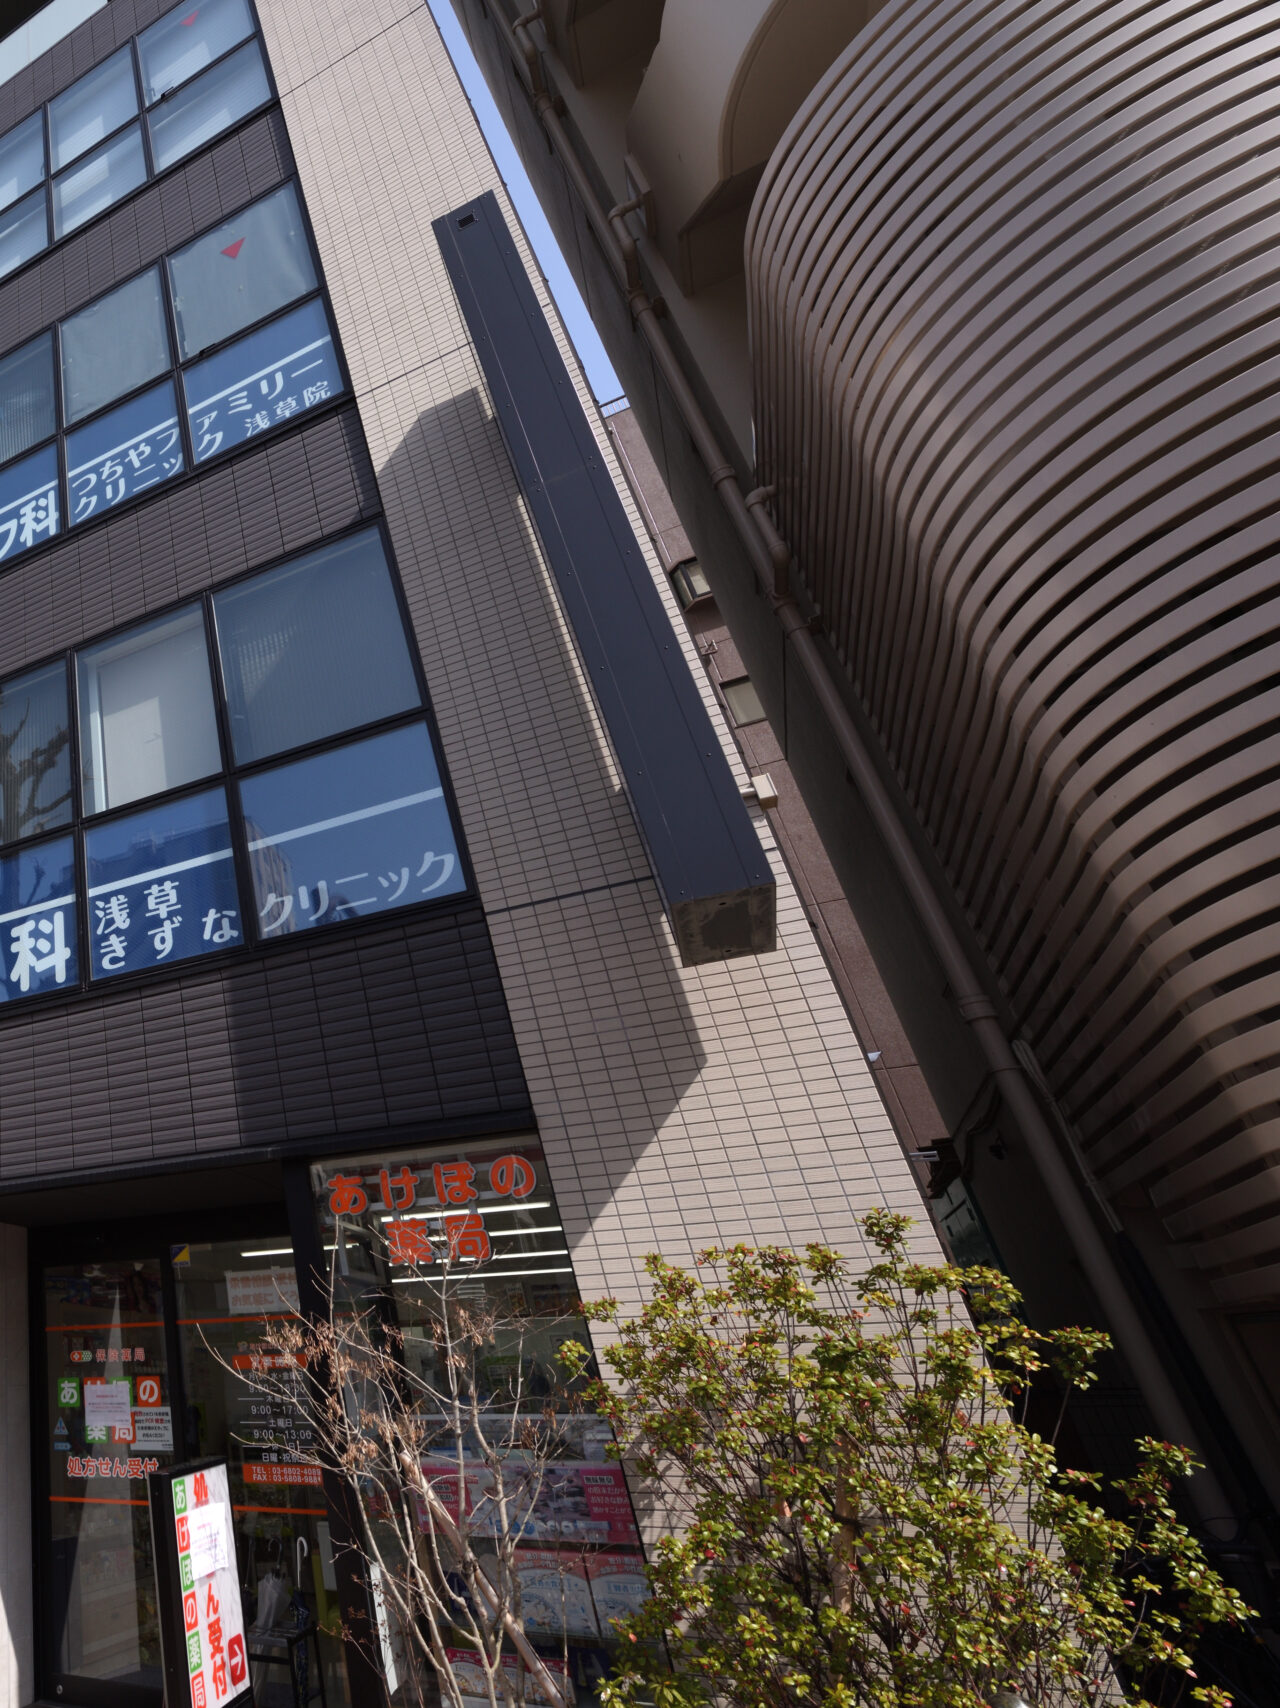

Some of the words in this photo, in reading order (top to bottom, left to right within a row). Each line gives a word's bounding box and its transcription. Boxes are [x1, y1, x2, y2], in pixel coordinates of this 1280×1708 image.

[244, 380, 331, 437] 浅草院
[95, 880, 181, 935] 浅草
[260, 851, 456, 932] クリニック
[328, 1154, 536, 1215] あけぼの
[384, 1213, 492, 1265] 薬局
[96, 1347, 145, 1362] 保険薬局
[269, 1418, 293, 1428] 土曜日
[67, 1456, 159, 1479] 処方せん受付
[193, 1472, 228, 1700] 処ん受付
